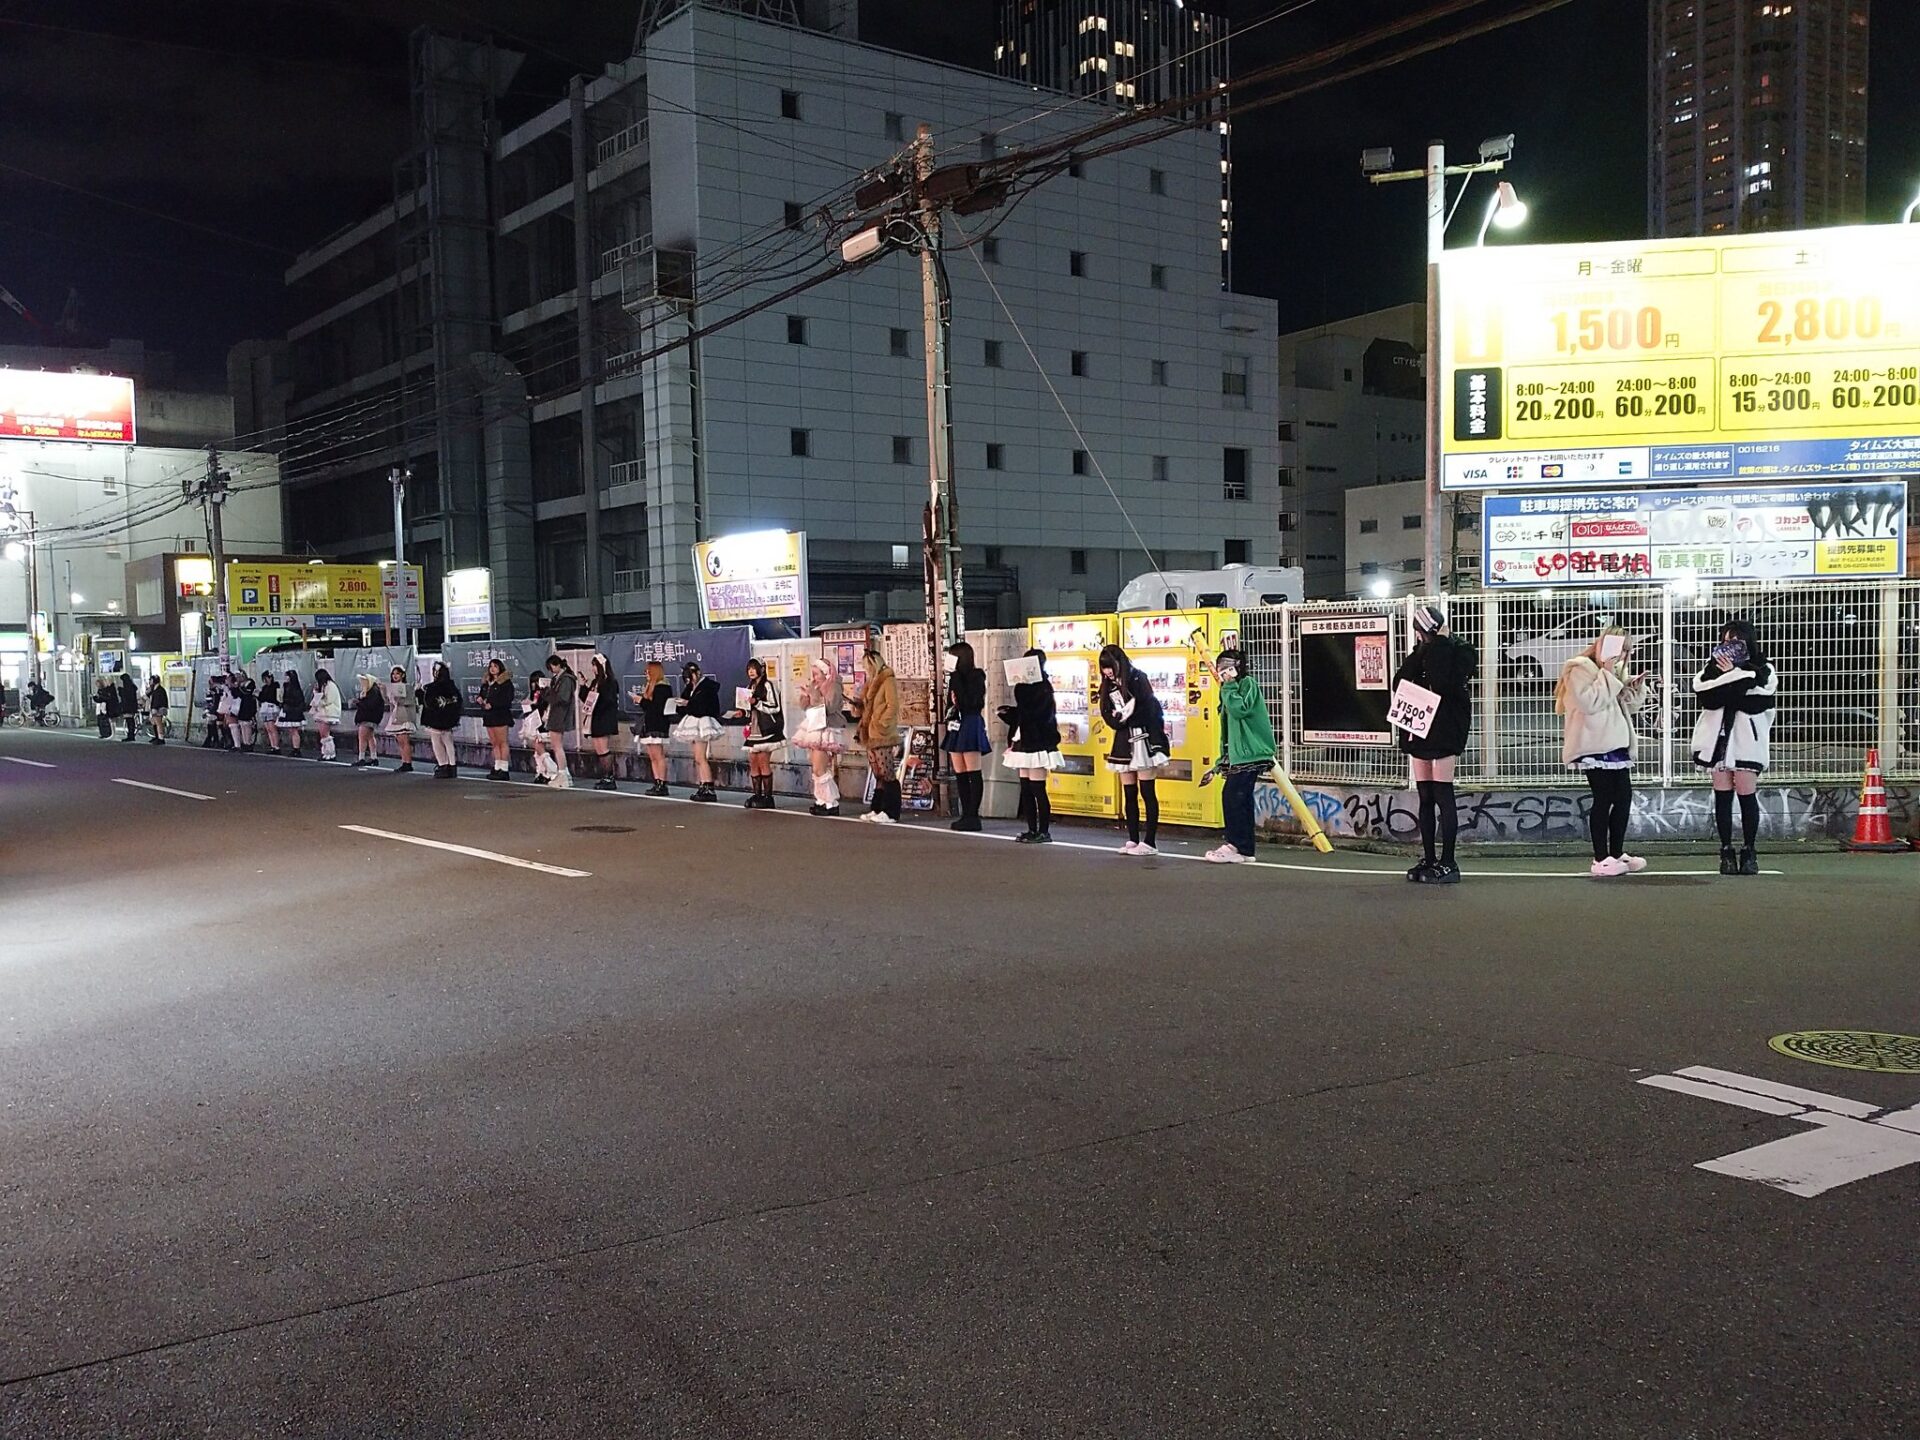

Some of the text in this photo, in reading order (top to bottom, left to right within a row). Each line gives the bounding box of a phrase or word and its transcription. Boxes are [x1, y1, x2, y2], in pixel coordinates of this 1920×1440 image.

[1463, 469, 1488, 479] VISA
[1519, 496, 1639, 513] 駐車場提携先ご案内
[1657, 553, 1725, 569] 信長書店
[1397, 699, 1426, 720] ¥1500
